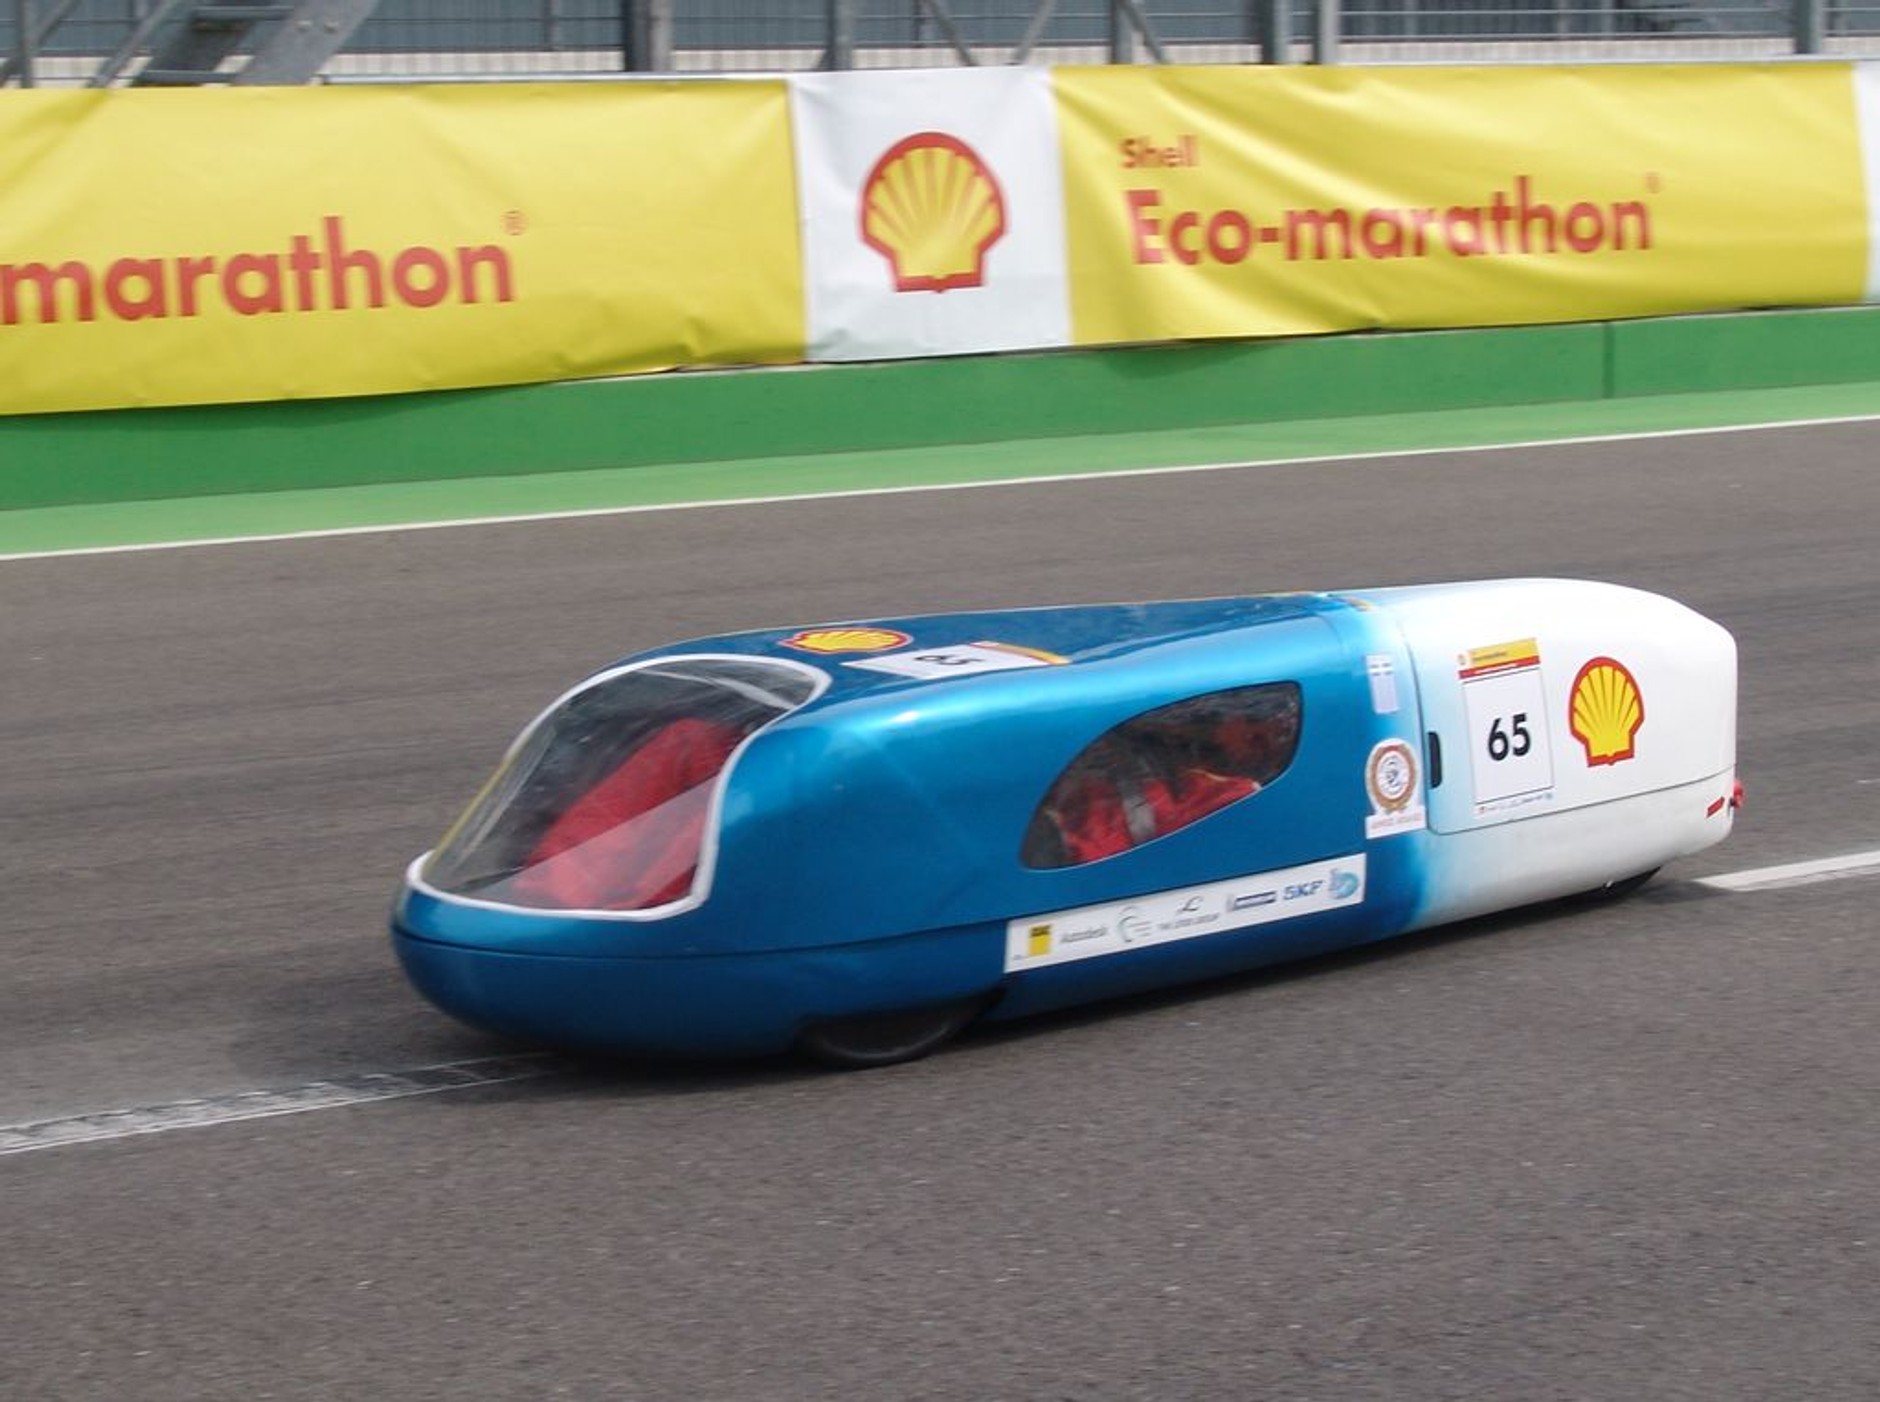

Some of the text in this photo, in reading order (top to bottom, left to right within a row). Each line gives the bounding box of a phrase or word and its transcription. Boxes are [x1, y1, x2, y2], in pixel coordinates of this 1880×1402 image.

[1120, 135, 1197, 168] Shell
[1124, 175, 1653, 265] Eco-marathon
[0, 215, 515, 325] marathon
[1488, 713, 1531, 762] 65
